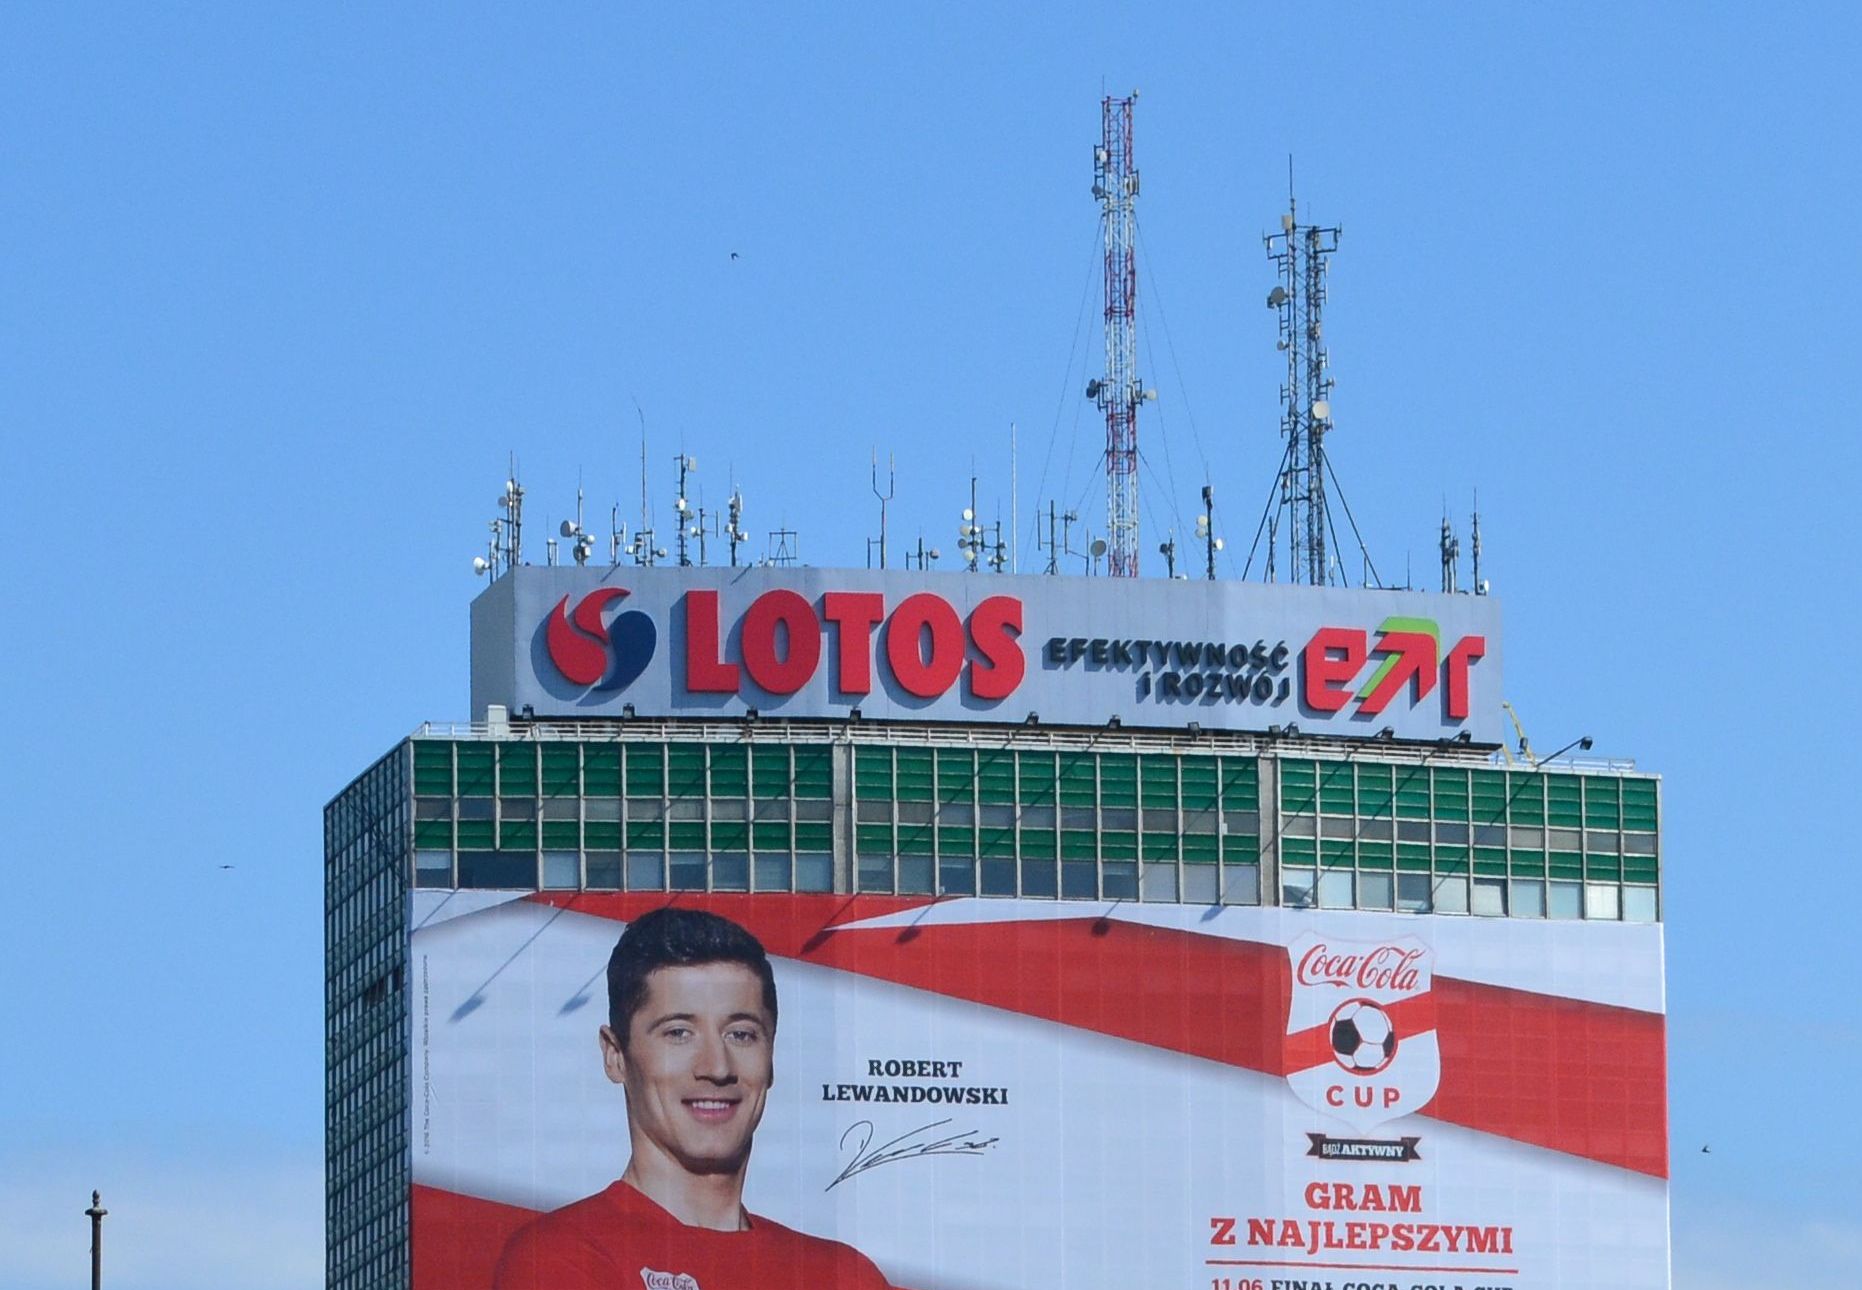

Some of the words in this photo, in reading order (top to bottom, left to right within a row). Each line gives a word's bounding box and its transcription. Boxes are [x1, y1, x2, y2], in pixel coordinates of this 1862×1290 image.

[686, 588, 1026, 700] LOTOS
[1048, 637, 1290, 672] EFEKTYWNOŚĆ
[1162, 669, 1291, 704] ROZWÓJ
[1297, 943, 1425, 991] Coca-Cola
[867, 1059, 963, 1078] ROBERT
[822, 1084, 1008, 1105] LEWANDOWSKI
[1326, 1084, 1400, 1108] CUP
[1341, 1143, 1404, 1157] AKTYWNY
[1304, 1182, 1422, 1212] GRAM
[1210, 1218, 1236, 1245] Z
[1247, 1218, 1513, 1255] NAJLEPSZYMI
